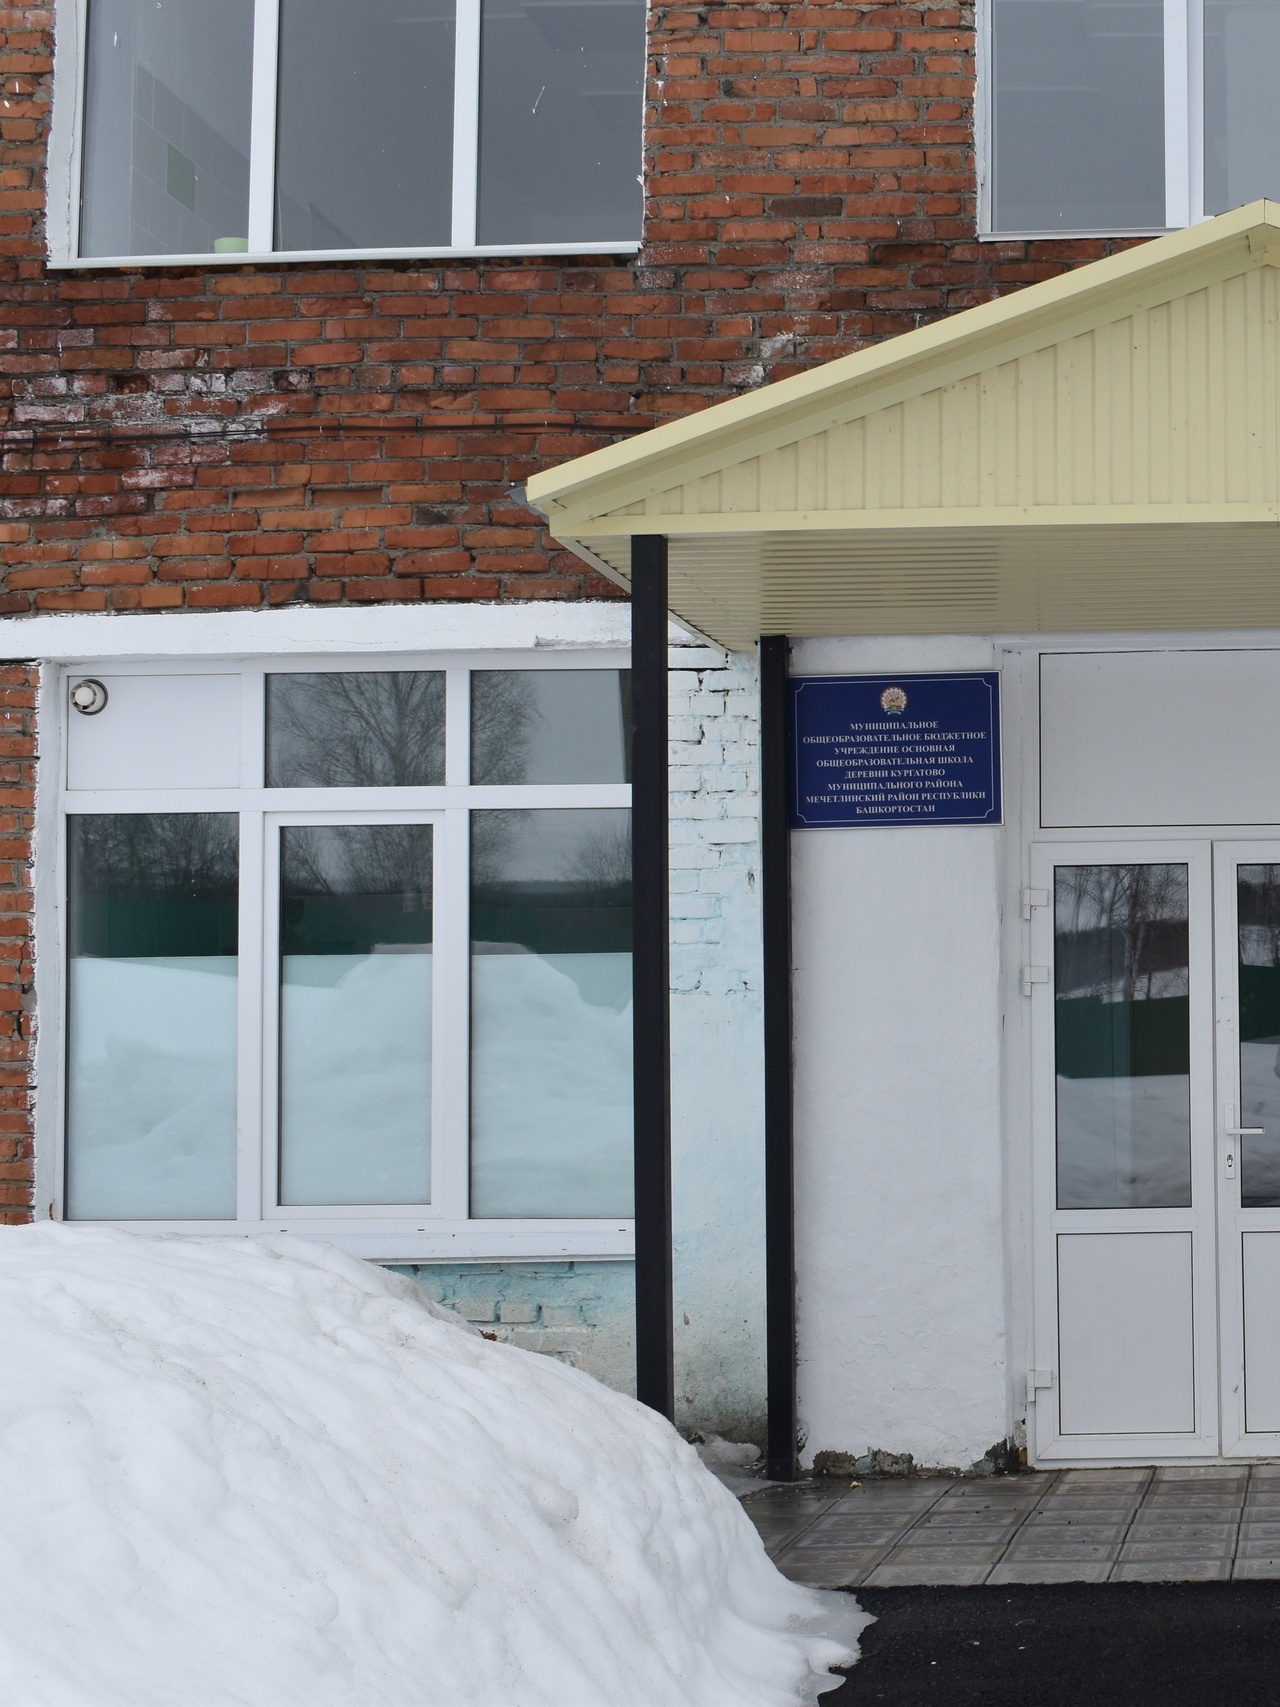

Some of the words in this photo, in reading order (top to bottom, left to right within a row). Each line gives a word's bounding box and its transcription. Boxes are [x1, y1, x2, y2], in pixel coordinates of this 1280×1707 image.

[850, 721, 939, 731] МУНИЦИПАЛЬНОЕ
[803, 733, 922, 745] ОБЩЕОБРАЗОВАТЕЛЬНОЕ
[924, 731, 986, 742] БЮДЖЕТНОЕ
[834, 746, 900, 756] УЧРЕЖДЕНИЕ
[901, 744, 955, 754] ОСНОВНАЯ
[816, 757, 935, 768] ОБЩЕОБРАЗОВАТЕЛЬНАЯ
[937, 756, 974, 765] ШКОЛА
[844, 770, 889, 780] ДЕРЕВНИ
[890, 768, 946, 778] КУРГАТОВО
[827, 781, 923, 792] МУНИЦИПАЛЬНОГО
[924, 779, 963, 789] РАЙОНА
[805, 793, 885, 804] МЕЧЕТЛИНСКИЙ
[887, 792, 920, 802] РАЙОН
[921, 791, 986, 801] РЕСПУБЛИКИ
[856, 805, 935, 814] БАШКОРТОСТАН
